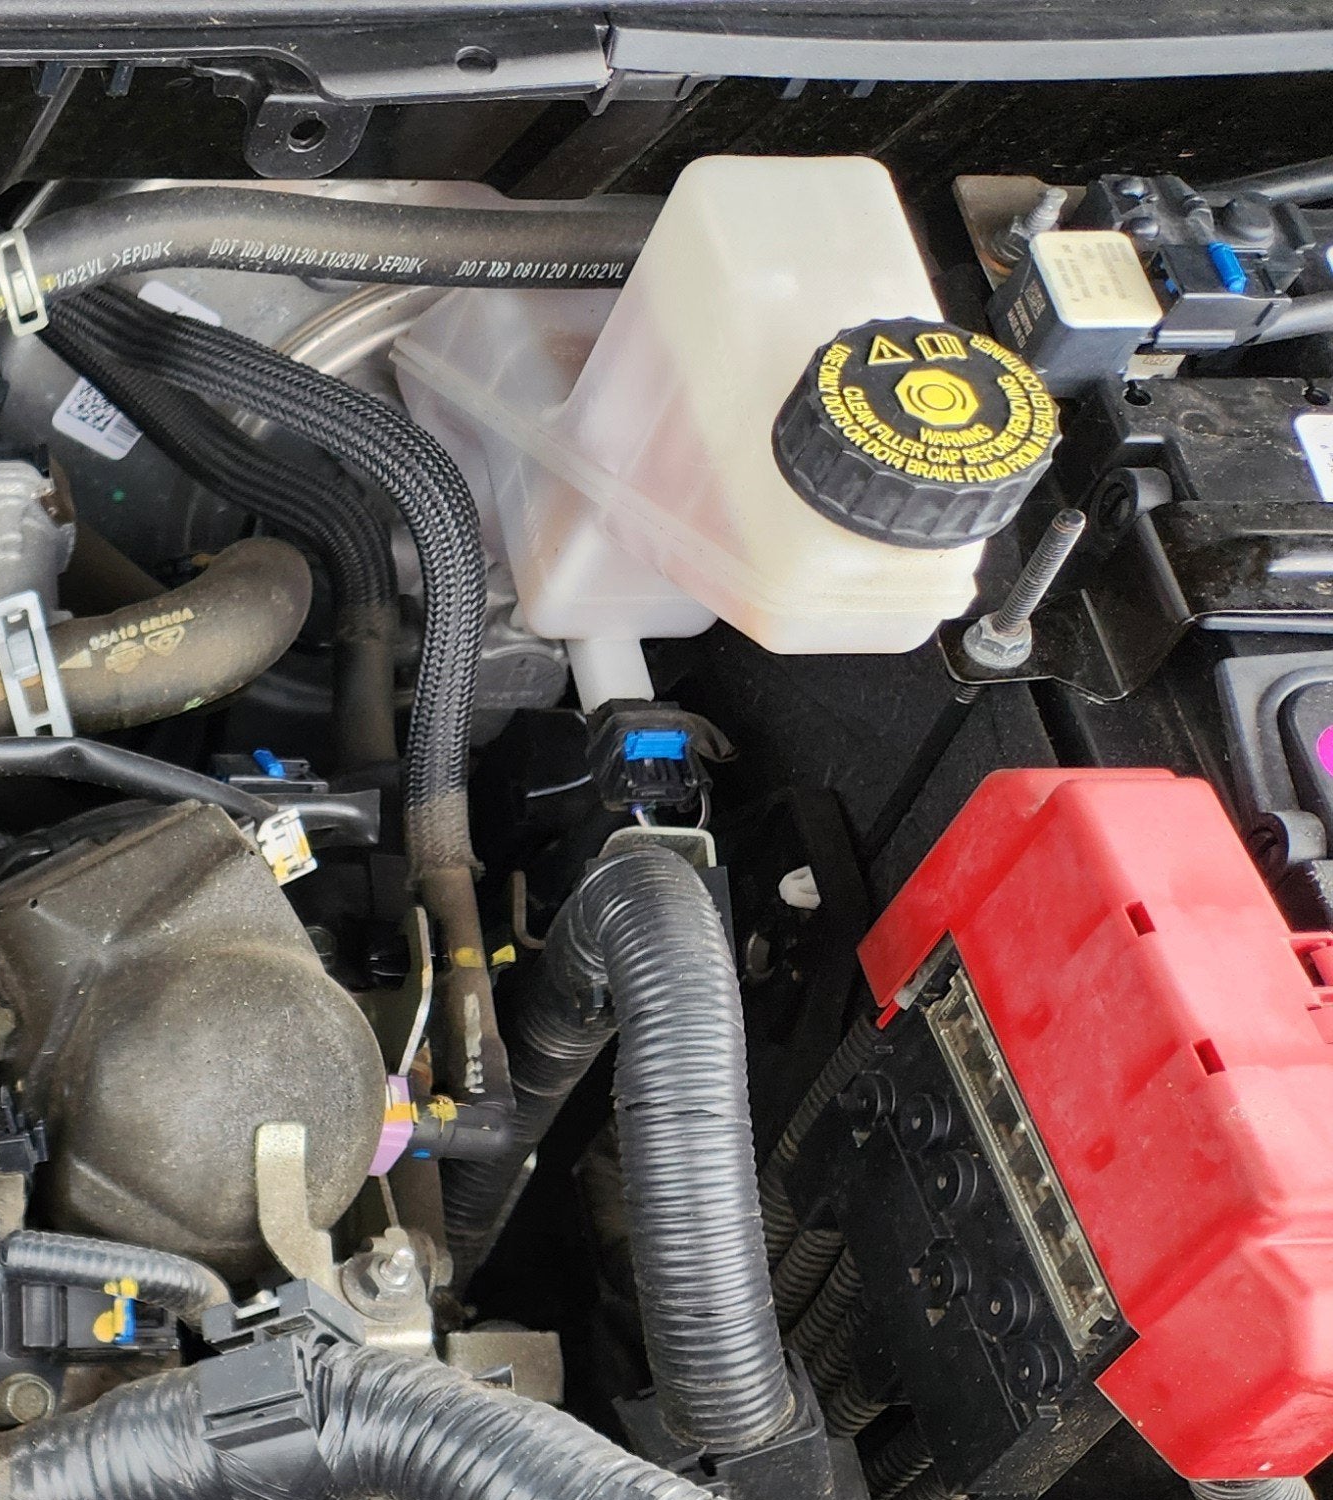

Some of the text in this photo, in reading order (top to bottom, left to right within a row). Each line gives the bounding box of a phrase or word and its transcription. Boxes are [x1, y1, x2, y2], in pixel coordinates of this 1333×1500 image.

[208, 238, 239, 257] DOT
[455, 260, 486, 278] DOT
[512, 261, 567, 279] 081120
[568, 262, 626, 280] 11/32VL
[822, 343, 852, 368] USE
[969, 334, 1044, 392] CONTAINER
[817, 364, 841, 395] ONLY
[821, 395, 854, 428] DOT3
[842, 373, 1033, 465] CLEAN FILLER CAP BEFORE REMOVING
[1029, 392, 1055, 438] SEALED
[842, 424, 870, 447] OR
[919, 422, 994, 447] WARNING
[1029, 435, 1050, 449] A
[861, 439, 907, 470] DOT4
[1003, 440, 1045, 473] FROM
[904, 458, 965, 483] BRAKE
[963, 459, 1013, 483] FLUID
